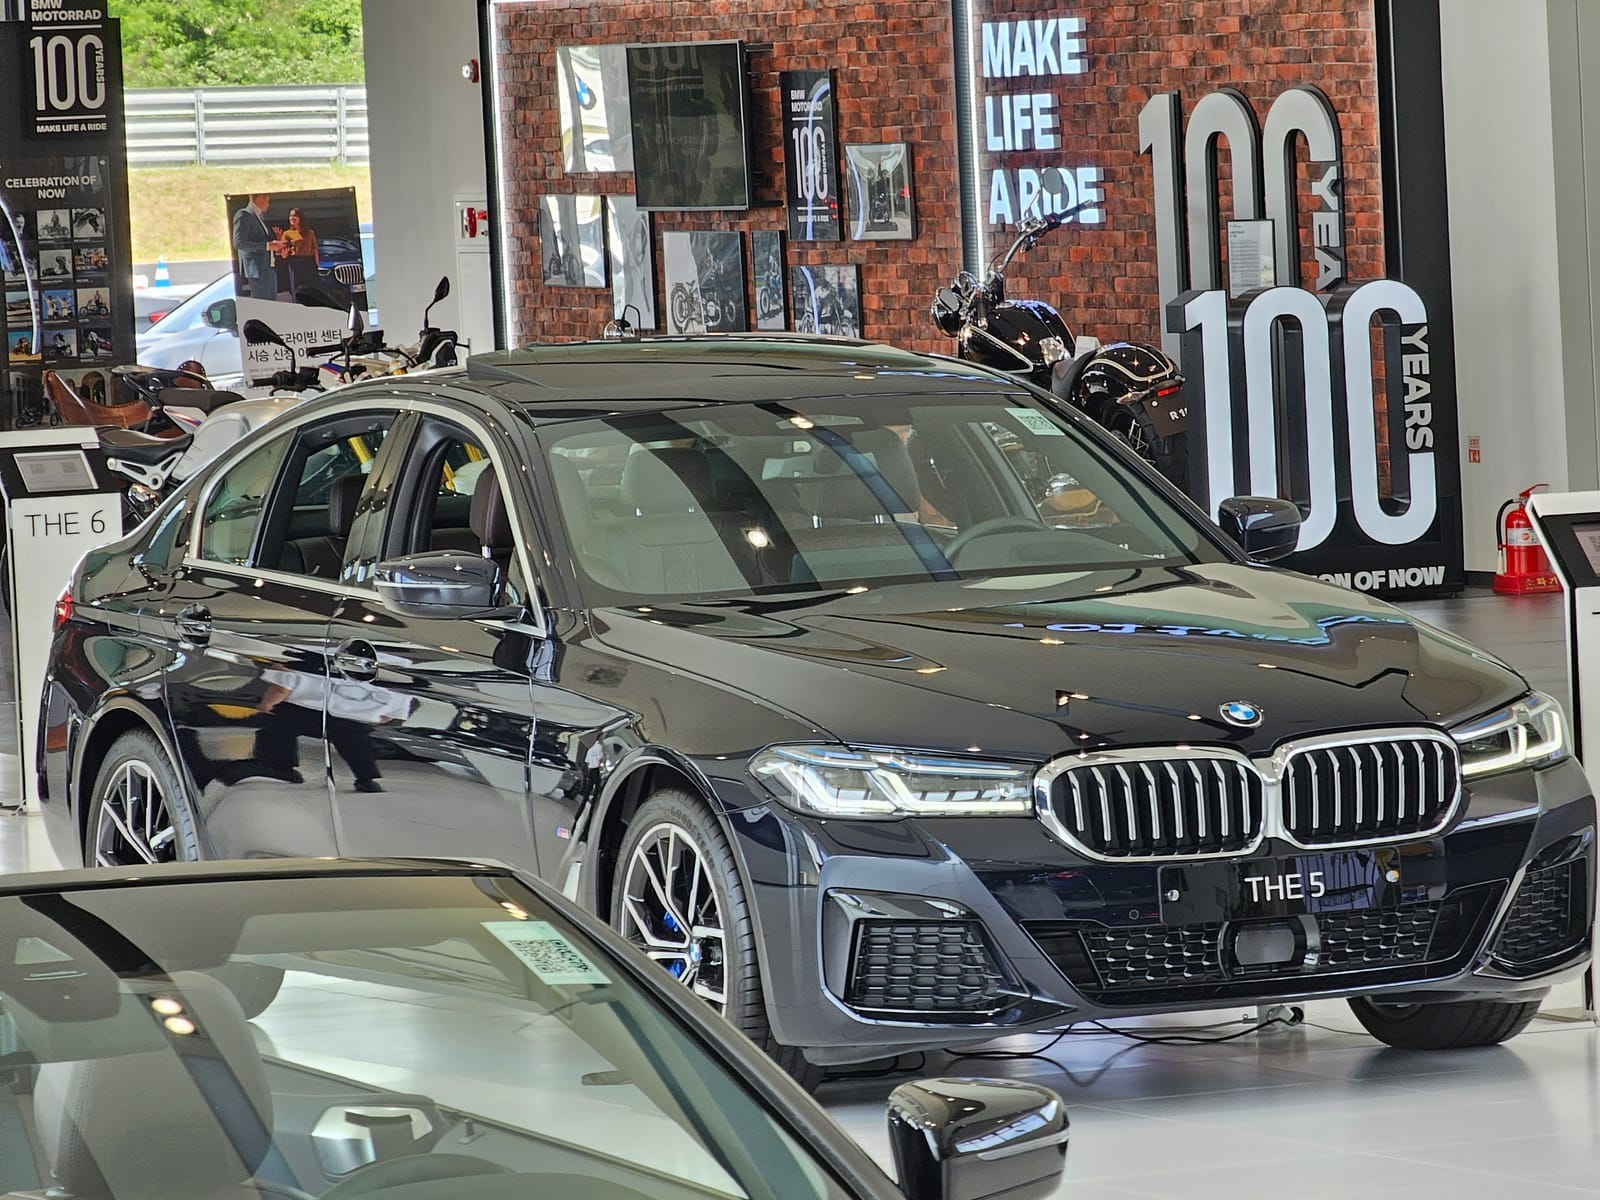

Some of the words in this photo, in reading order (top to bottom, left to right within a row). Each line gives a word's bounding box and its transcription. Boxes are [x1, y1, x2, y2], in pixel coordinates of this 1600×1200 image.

[31, 0, 63, 9] BMW
[31, 9, 102, 21] MOTORRAD
[982, 17, 1083, 78] MAKE
[30, 34, 106, 111] 100
[95, 48, 104, 83] YEARS
[791, 100, 823, 112] MOTORAD
[36, 124, 61, 133] MAKE
[62, 124, 80, 132] LIFE
[80, 123, 87, 131] A
[87, 122, 107, 131] RIDE
[985, 93, 1057, 151] LIFE
[5, 176, 80, 188] CELEBRATION
[82, 175, 97, 186] OF
[38, 188, 66, 200] NOW
[989, 169, 1014, 225] A
[1018, 166, 1103, 224] RIDE
[1311, 165, 1343, 295] YEA
[321, 329, 342, 341] 센터
[248, 350, 269, 362] 시승
[1400, 325, 1434, 450] YEARS
[1169, 410, 1180, 420] R
[1184, 279, 1437, 552] 100
[24, 512, 80, 537] THE
[91, 509, 105, 534] 6
[1354, 570, 1386, 591] OF
[1388, 566, 1446, 589] NOW
[1244, 873, 1304, 903] THE
[1309, 871, 1326, 898] 5
